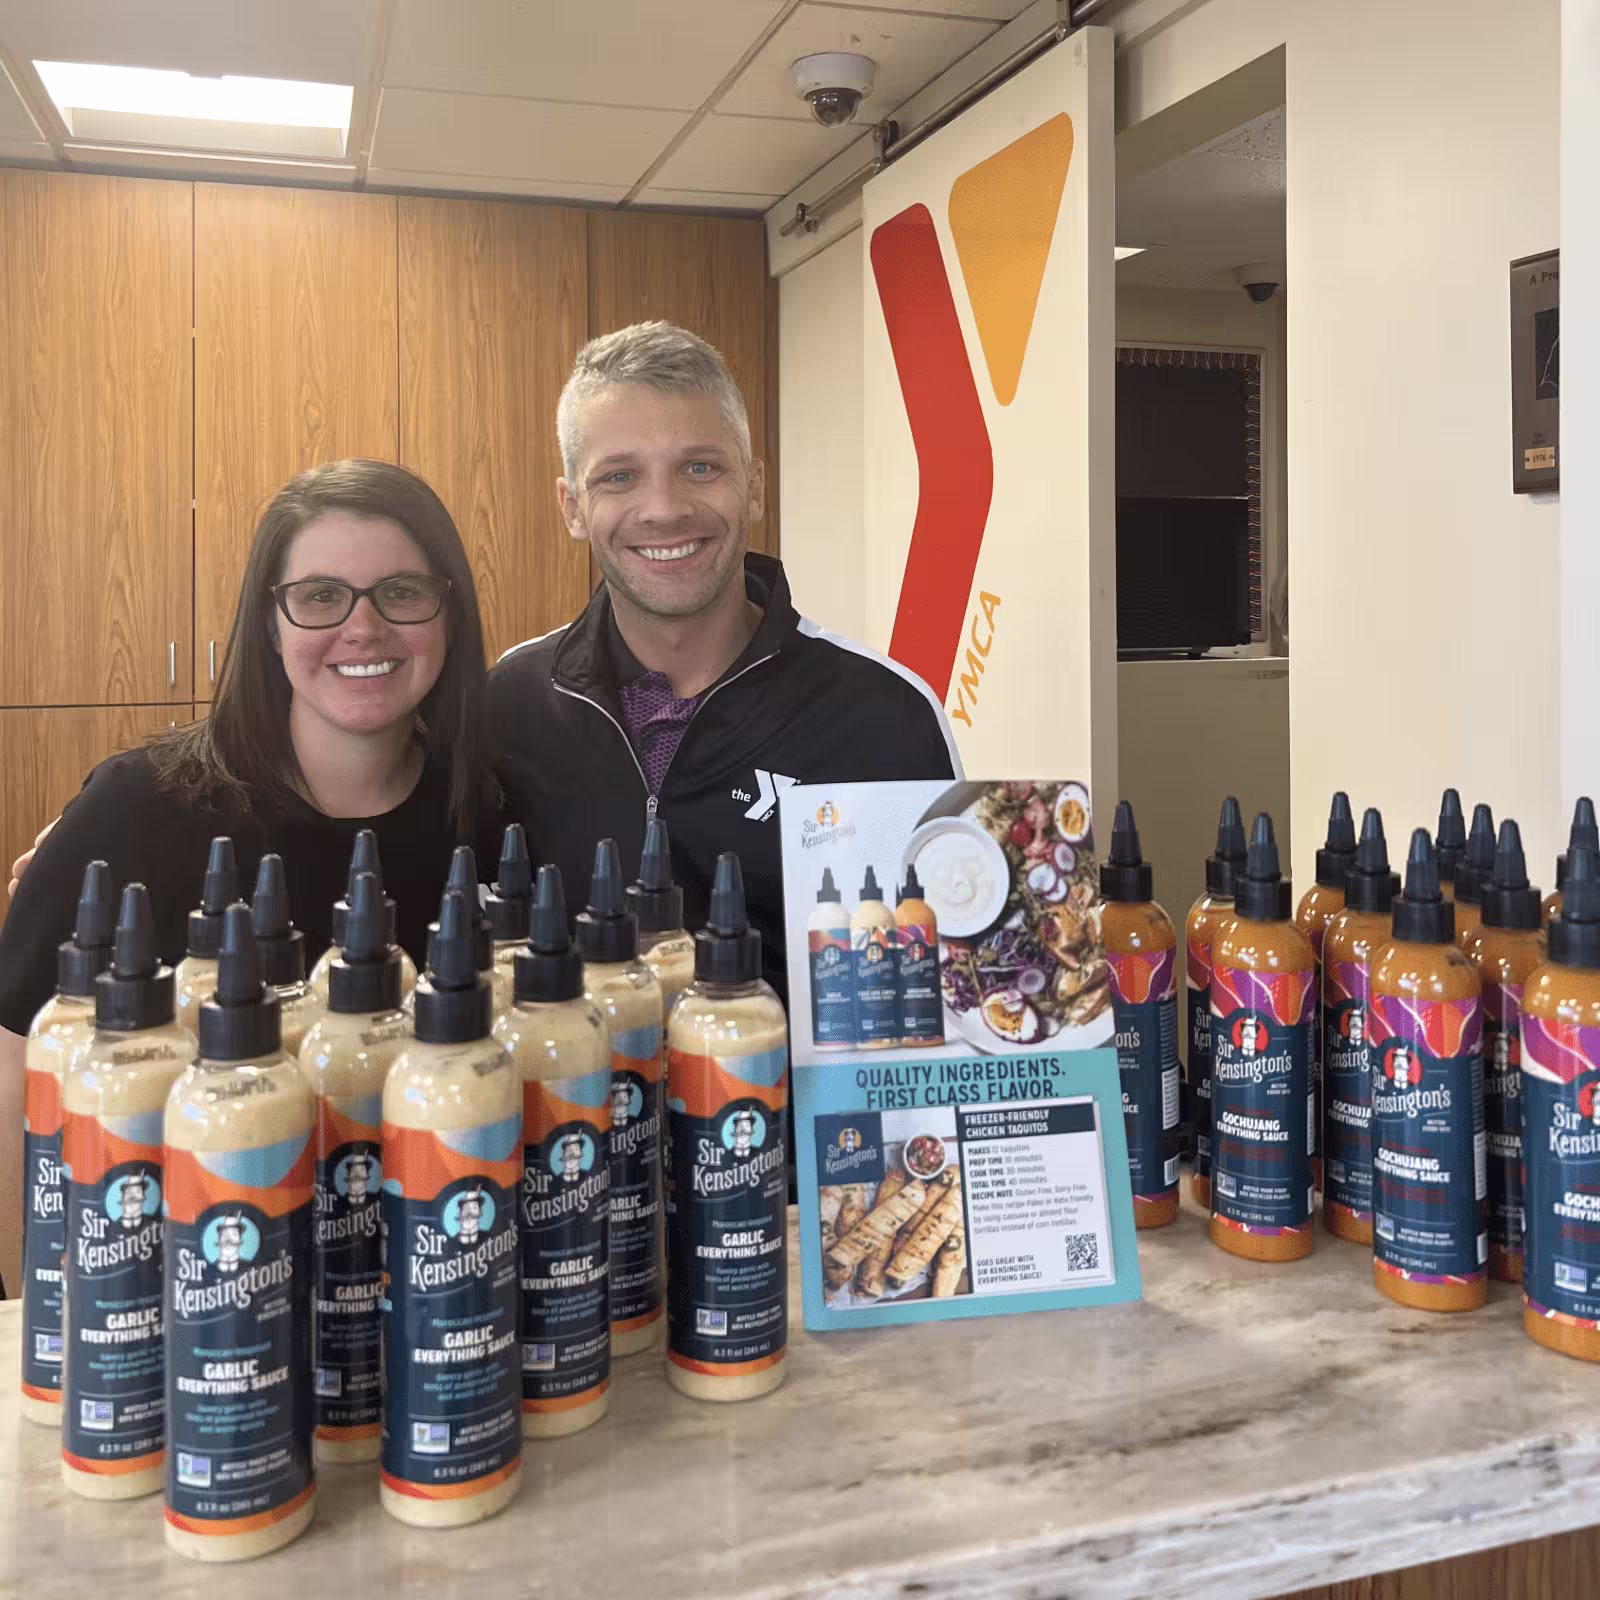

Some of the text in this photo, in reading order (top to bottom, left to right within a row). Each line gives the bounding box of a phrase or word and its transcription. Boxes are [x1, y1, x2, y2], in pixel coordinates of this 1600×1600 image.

[952, 590, 1001, 728] YMCA
[731, 788, 751, 803] the
[1217, 1034, 1235, 1058] Sir
[855, 1057, 1066, 1090] QUALITY INGREDIENTS.
[1215, 1049, 1292, 1083] Kensington's
[1372, 1065, 1387, 1091] Sir
[867, 1079, 1060, 1109] FIRST CLASS FLAVOR.
[965, 1109, 1050, 1126] FREEZER-FRIENDLY
[1333, 1099, 1373, 1118] GOCHUJA
[1553, 1102, 1582, 1130] Sir
[966, 1121, 1049, 1139] CHICKEN TAQUITOS
[1216, 1120, 1289, 1141] EVERYTHING SAUCE
[1222, 1111, 1281, 1132] GOCHUJANG
[699, 1138, 725, 1166] Sir
[968, 1146, 991, 1156] MAKES
[1549, 1126, 1600, 1159] Kensi
[38, 1157, 63, 1185] Sir
[693, 1138, 784, 1197] Kensington's
[969, 1157, 987, 1167] PREP
[988, 1156, 1003, 1165] TIME
[1014, 1154, 1043, 1163] minutes
[1374, 1157, 1418, 1180] EVERYTHING
[1420, 1170, 1451, 1183] SAUCE
[1378, 1147, 1440, 1171] GOCHUJANG
[525, 1167, 553, 1194] Sir
[970, 1168, 988, 1178] COOK
[989, 1167, 1004, 1176] TIME
[1017, 1165, 1046, 1174] minutes
[971, 1180, 990, 1190] TOTAL
[991, 1178, 1006, 1187] TIME
[1018, 1175, 1048, 1184] minutes
[610, 1195, 638, 1212] ARLIC
[971, 1191, 995, 1201] RECIPE
[996, 1189, 1013, 1199] NOTE
[82, 1207, 110, 1238] Sir
[416, 1223, 448, 1256] Sir
[696, 1236, 782, 1260] EVERYTHING SAUCE
[722, 1229, 765, 1247] GARLIC
[178, 1247, 208, 1281] Sir
[409, 1219, 519, 1293] Kensington's
[550, 1256, 594, 1277] GARLIC
[976, 1254, 1034, 1267] GOES GREAT WITH
[977, 1274, 1018, 1285] EVERYTHING
[989, 1263, 1037, 1275] KENSINGTON'S
[173, 1249, 293, 1319] Kensington's
[522, 1273, 587, 1290] EVERYTHING
[106, 1307, 160, 1331] GARLIC
[80, 1323, 151, 1345] EVERYTHING
[444, 1325, 495, 1349] GARLIC
[413, 1329, 516, 1364] EVERYTHING SAUCE
[177, 1365, 289, 1395] EVERYTHING SAUCE
[203, 1359, 260, 1381] GARLIC
